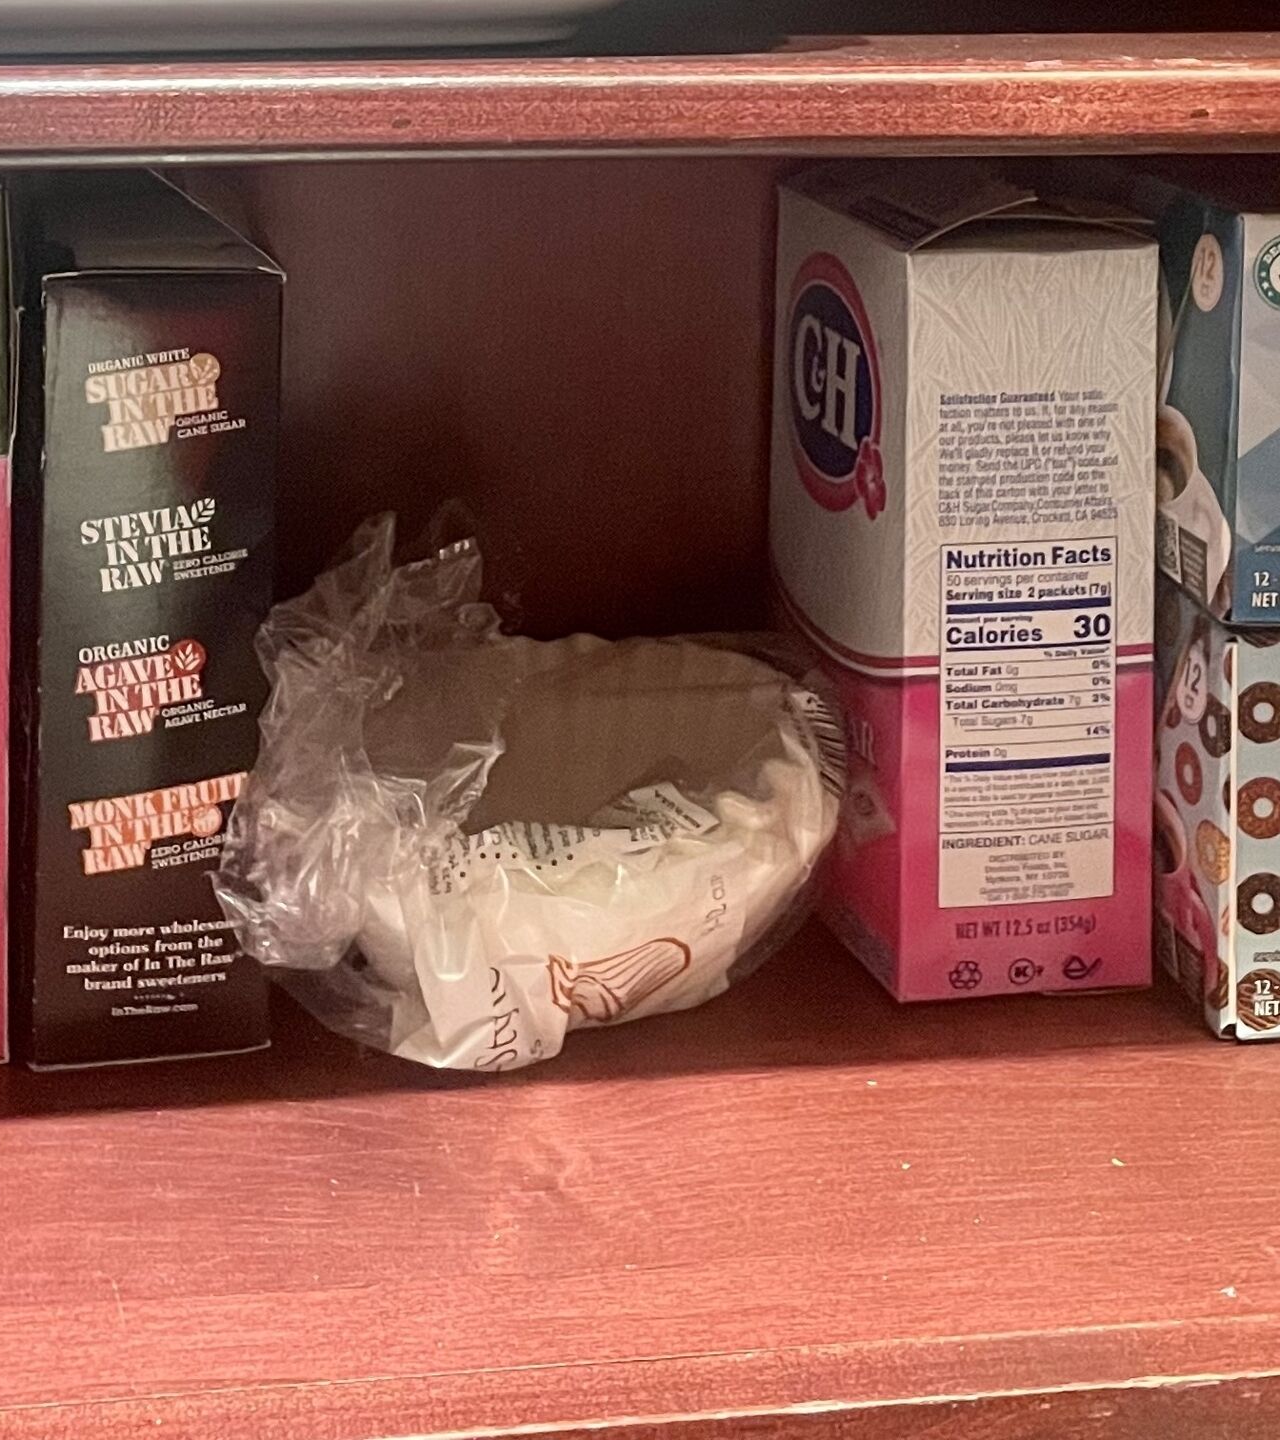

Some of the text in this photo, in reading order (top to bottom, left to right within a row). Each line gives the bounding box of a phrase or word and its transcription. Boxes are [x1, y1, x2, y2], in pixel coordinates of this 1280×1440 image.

[88, 349, 190, 374] ORGANIC WHITE
[86, 365, 191, 403] SUGAR
[794, 314, 861, 451] C&H
[108, 385, 218, 425] IN THE
[176, 411, 228, 428] ORGANIC
[177, 419, 246, 439] CANE SUGAR
[102, 418, 169, 452] RAW
[939, 503, 960, 513] C&H
[81, 505, 194, 545] STEVIA
[106, 526, 211, 566] IN THE
[947, 545, 1111, 568] Nutrition Facts
[100, 560, 165, 592] RAW
[947, 571, 1088, 587] 50 servings per container
[1254, 572, 1270, 586] 12
[947, 589, 993, 601] Serving
[998, 588, 1021, 598] size
[1028, 587, 1034, 597] 2
[1038, 584, 1086, 599] packets
[1252, 593, 1278, 607] NET
[946, 614, 1111, 645] Calories 30
[78, 635, 170, 664] ORGANIC
[76, 655, 174, 694] AGAVE
[946, 666, 978, 676] Total
[982, 666, 1001, 675] Fat
[95, 674, 202, 715] IN THE
[946, 677, 1110, 694] Sodium 0mg 0%
[162, 700, 214, 717] ORGANIC
[946, 700, 977, 710] Total
[982, 695, 1064, 710] Carbohydrate
[1069, 695, 1081, 705] 7g
[88, 708, 155, 742] RAW
[165, 703, 247, 728] AGAVE NECTAR
[953, 715, 1033, 727] Total Sugars 7g
[1086, 726, 1110, 735] 14%
[946, 748, 1007, 758] Protein 0g
[69, 794, 157, 829] MONK
[89, 811, 191, 848] IN THE
[942, 829, 1109, 849] INGREDIENT: CANE SUGAR
[83, 843, 147, 875] RAW
[63, 925, 108, 941] Enjoy
[113, 926, 155, 937] more
[956, 922, 978, 938] NET
[983, 921, 1001, 936] WT
[88, 936, 223, 958] options from the
[66, 961, 118, 974] maker
[123, 959, 139, 972] of
[145, 958, 160, 971] In
[165, 955, 196, 968] The
[84, 972, 226, 990] brand sweeteners
[1254, 980, 1271, 995] 12
[1254, 1000, 1280, 1016] NET
